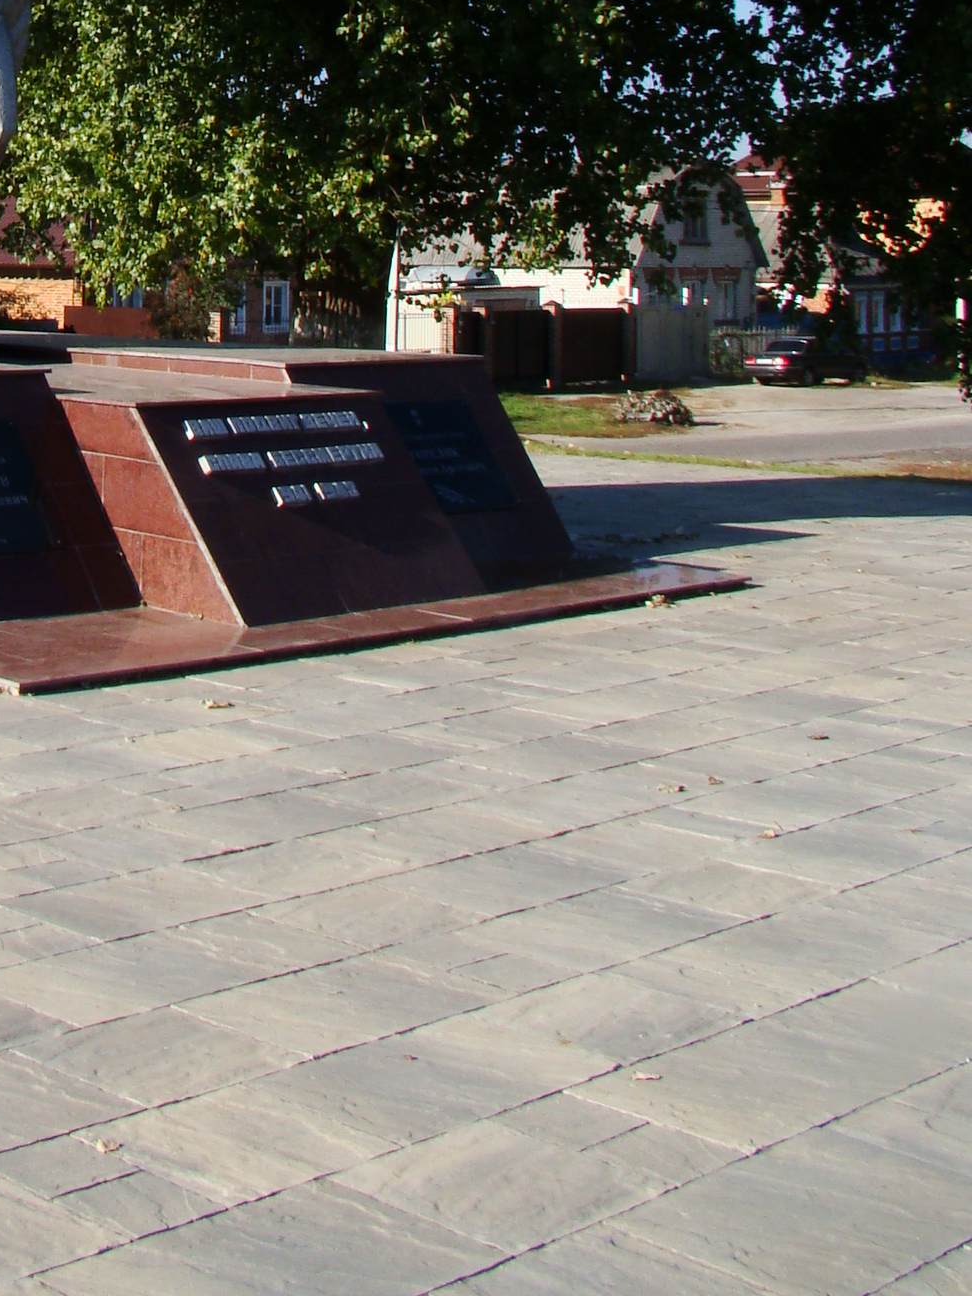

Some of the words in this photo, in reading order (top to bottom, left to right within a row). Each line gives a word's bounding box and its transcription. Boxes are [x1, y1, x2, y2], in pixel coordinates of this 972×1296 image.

[184, 418, 229, 441] ВАШ
[227, 413, 299, 435] ПОДВИГ
[198, 452, 266, 476] СЛАВА
[267, 442, 385, 468] БЕССМЕРТНА
